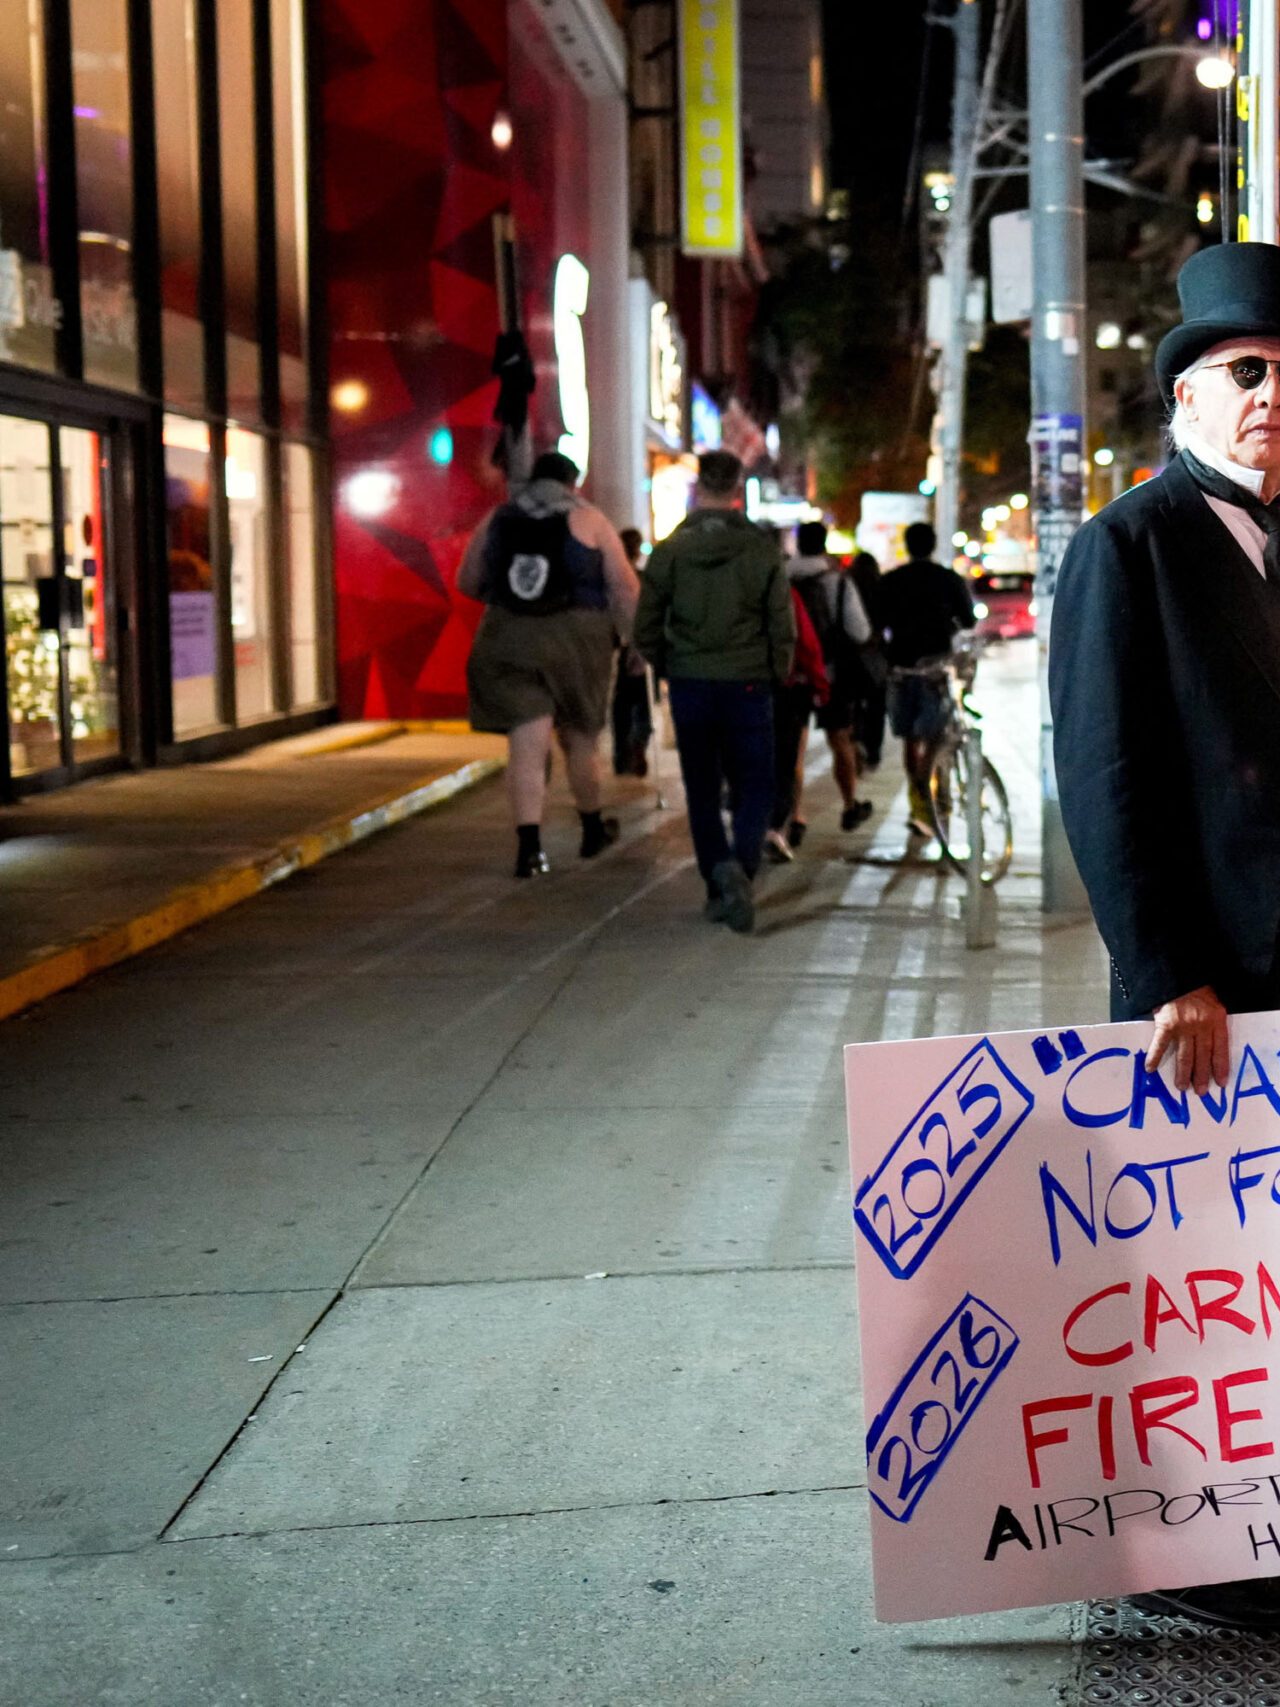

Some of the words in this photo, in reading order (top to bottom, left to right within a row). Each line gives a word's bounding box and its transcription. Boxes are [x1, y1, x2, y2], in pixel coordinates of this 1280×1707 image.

[872, 1056, 1003, 1256] 2025
[1039, 1148, 1211, 1267] NOT
[877, 1310, 1002, 1501] 2026
[1022, 1367, 1275, 1489] FIRE
